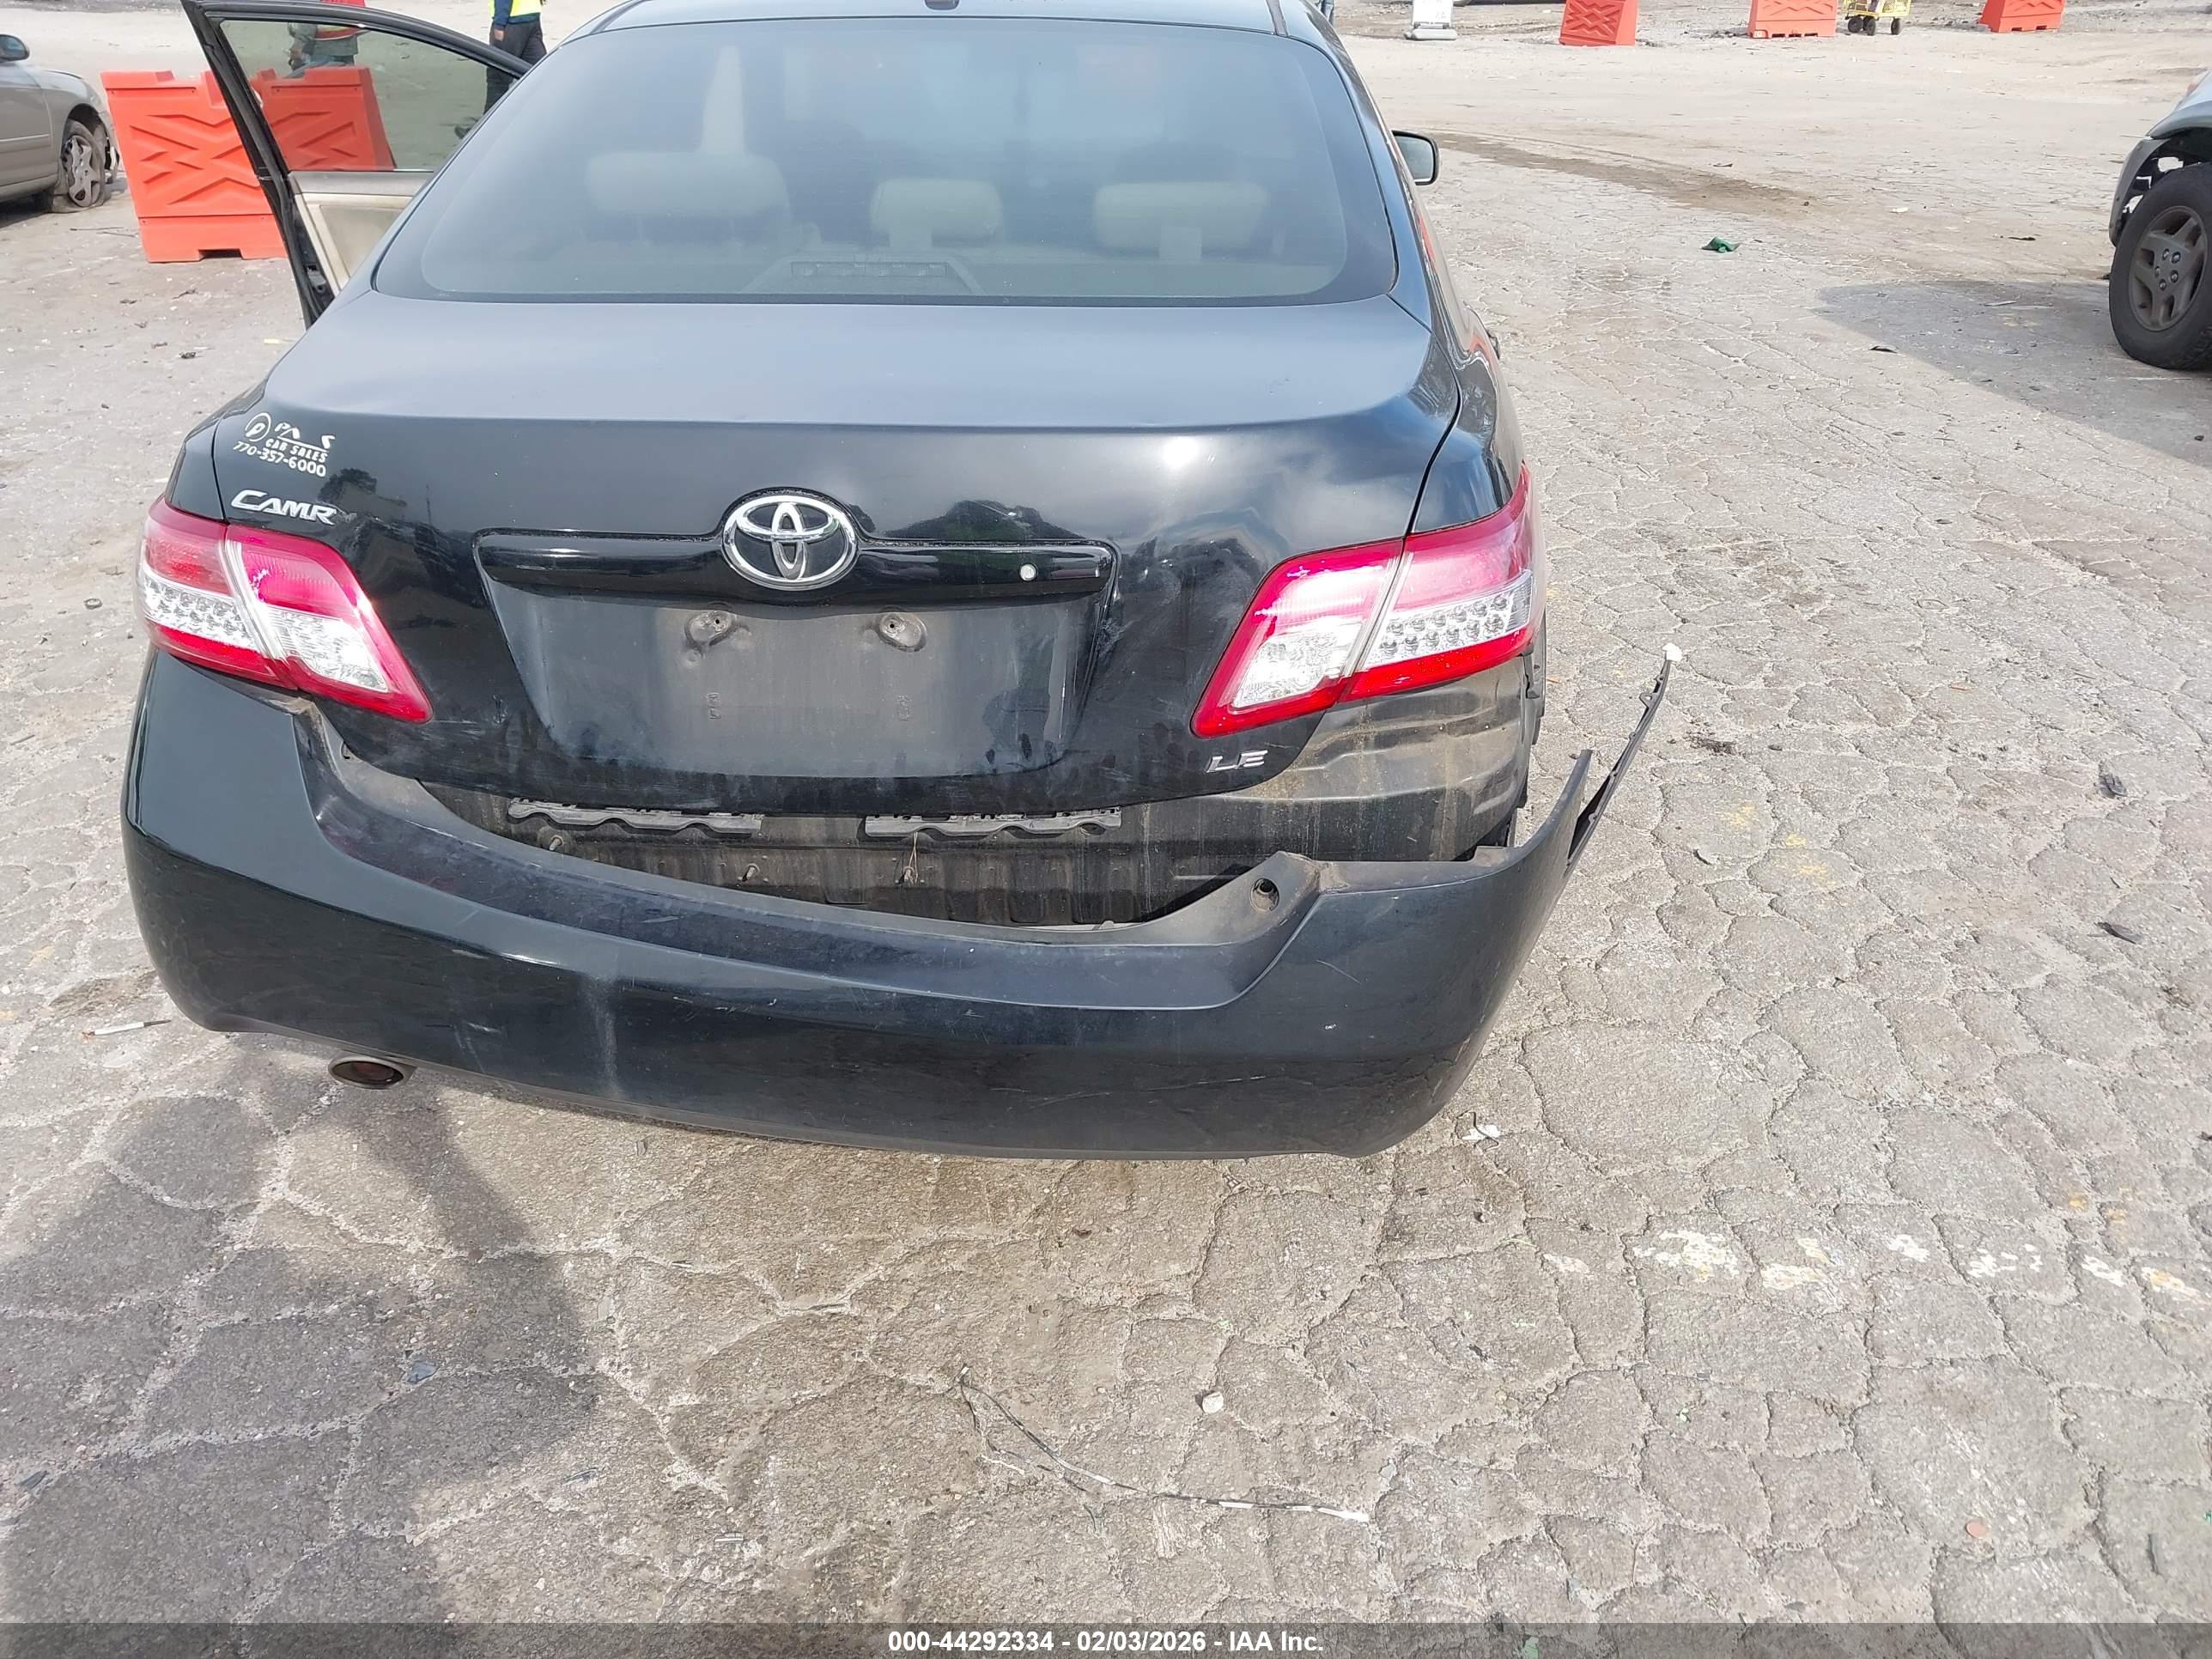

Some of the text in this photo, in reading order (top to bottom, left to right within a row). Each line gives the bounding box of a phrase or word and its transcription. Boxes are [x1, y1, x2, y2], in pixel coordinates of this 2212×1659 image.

[233, 441, 327, 477] 770-357-6000
[265, 438, 328, 464] CAR SALES
[1205, 750, 1268, 774] LE
